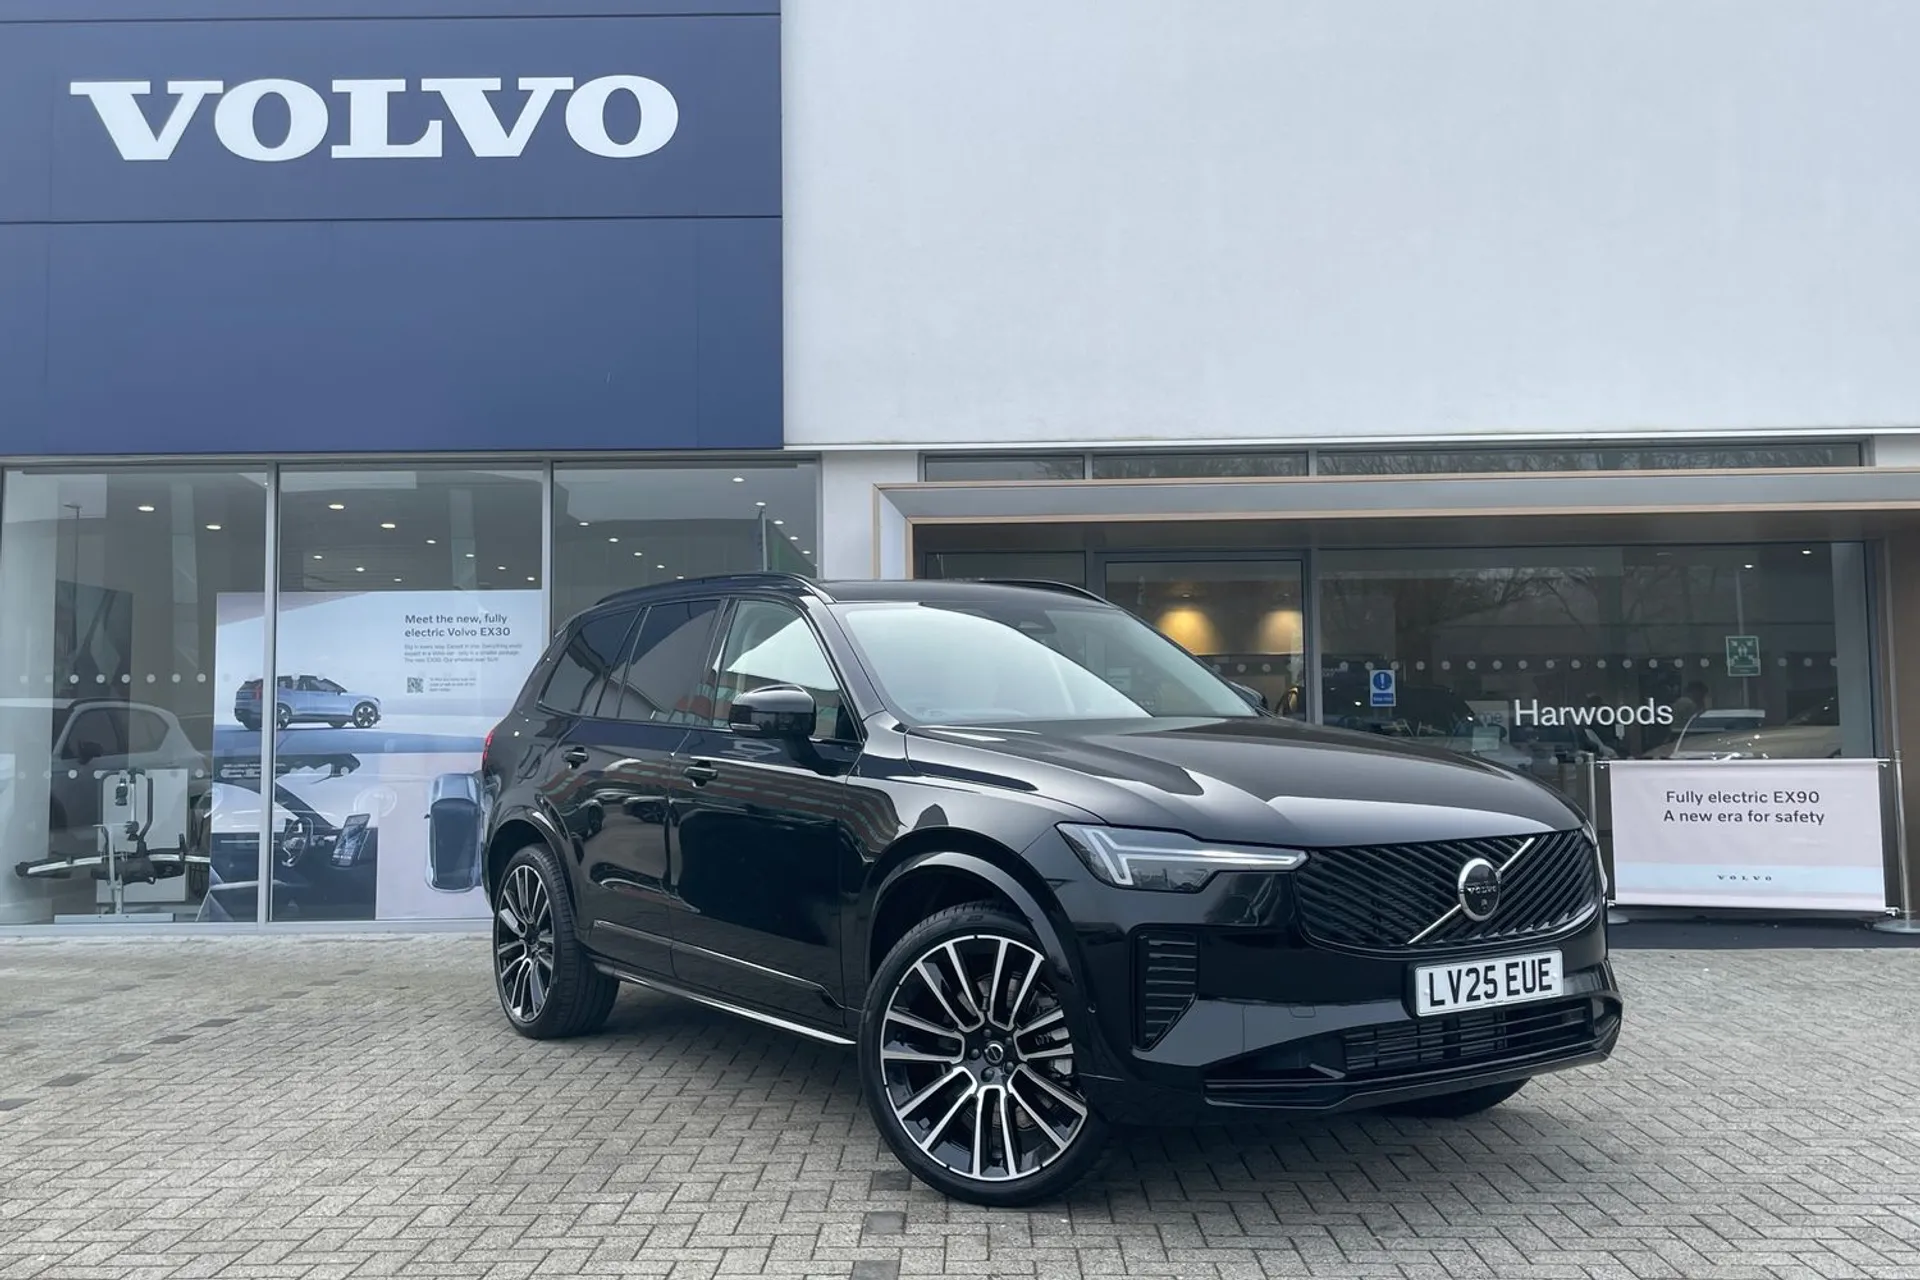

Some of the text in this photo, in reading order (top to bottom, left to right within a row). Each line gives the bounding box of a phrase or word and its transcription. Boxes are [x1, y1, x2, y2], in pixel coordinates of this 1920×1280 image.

[70, 74, 679, 162] VOLVO
[404, 613, 508, 625] Meet the new, fully
[404, 627, 511, 638] electric Volvo EX30
[1514, 697, 1674, 727] Harwoods
[1666, 790, 1820, 806] Fully electric EX90
[1663, 809, 1825, 826] A new era for safety
[1717, 874, 1773, 882] VOLVO
[1428, 957, 1553, 1007] LV25 EUE
